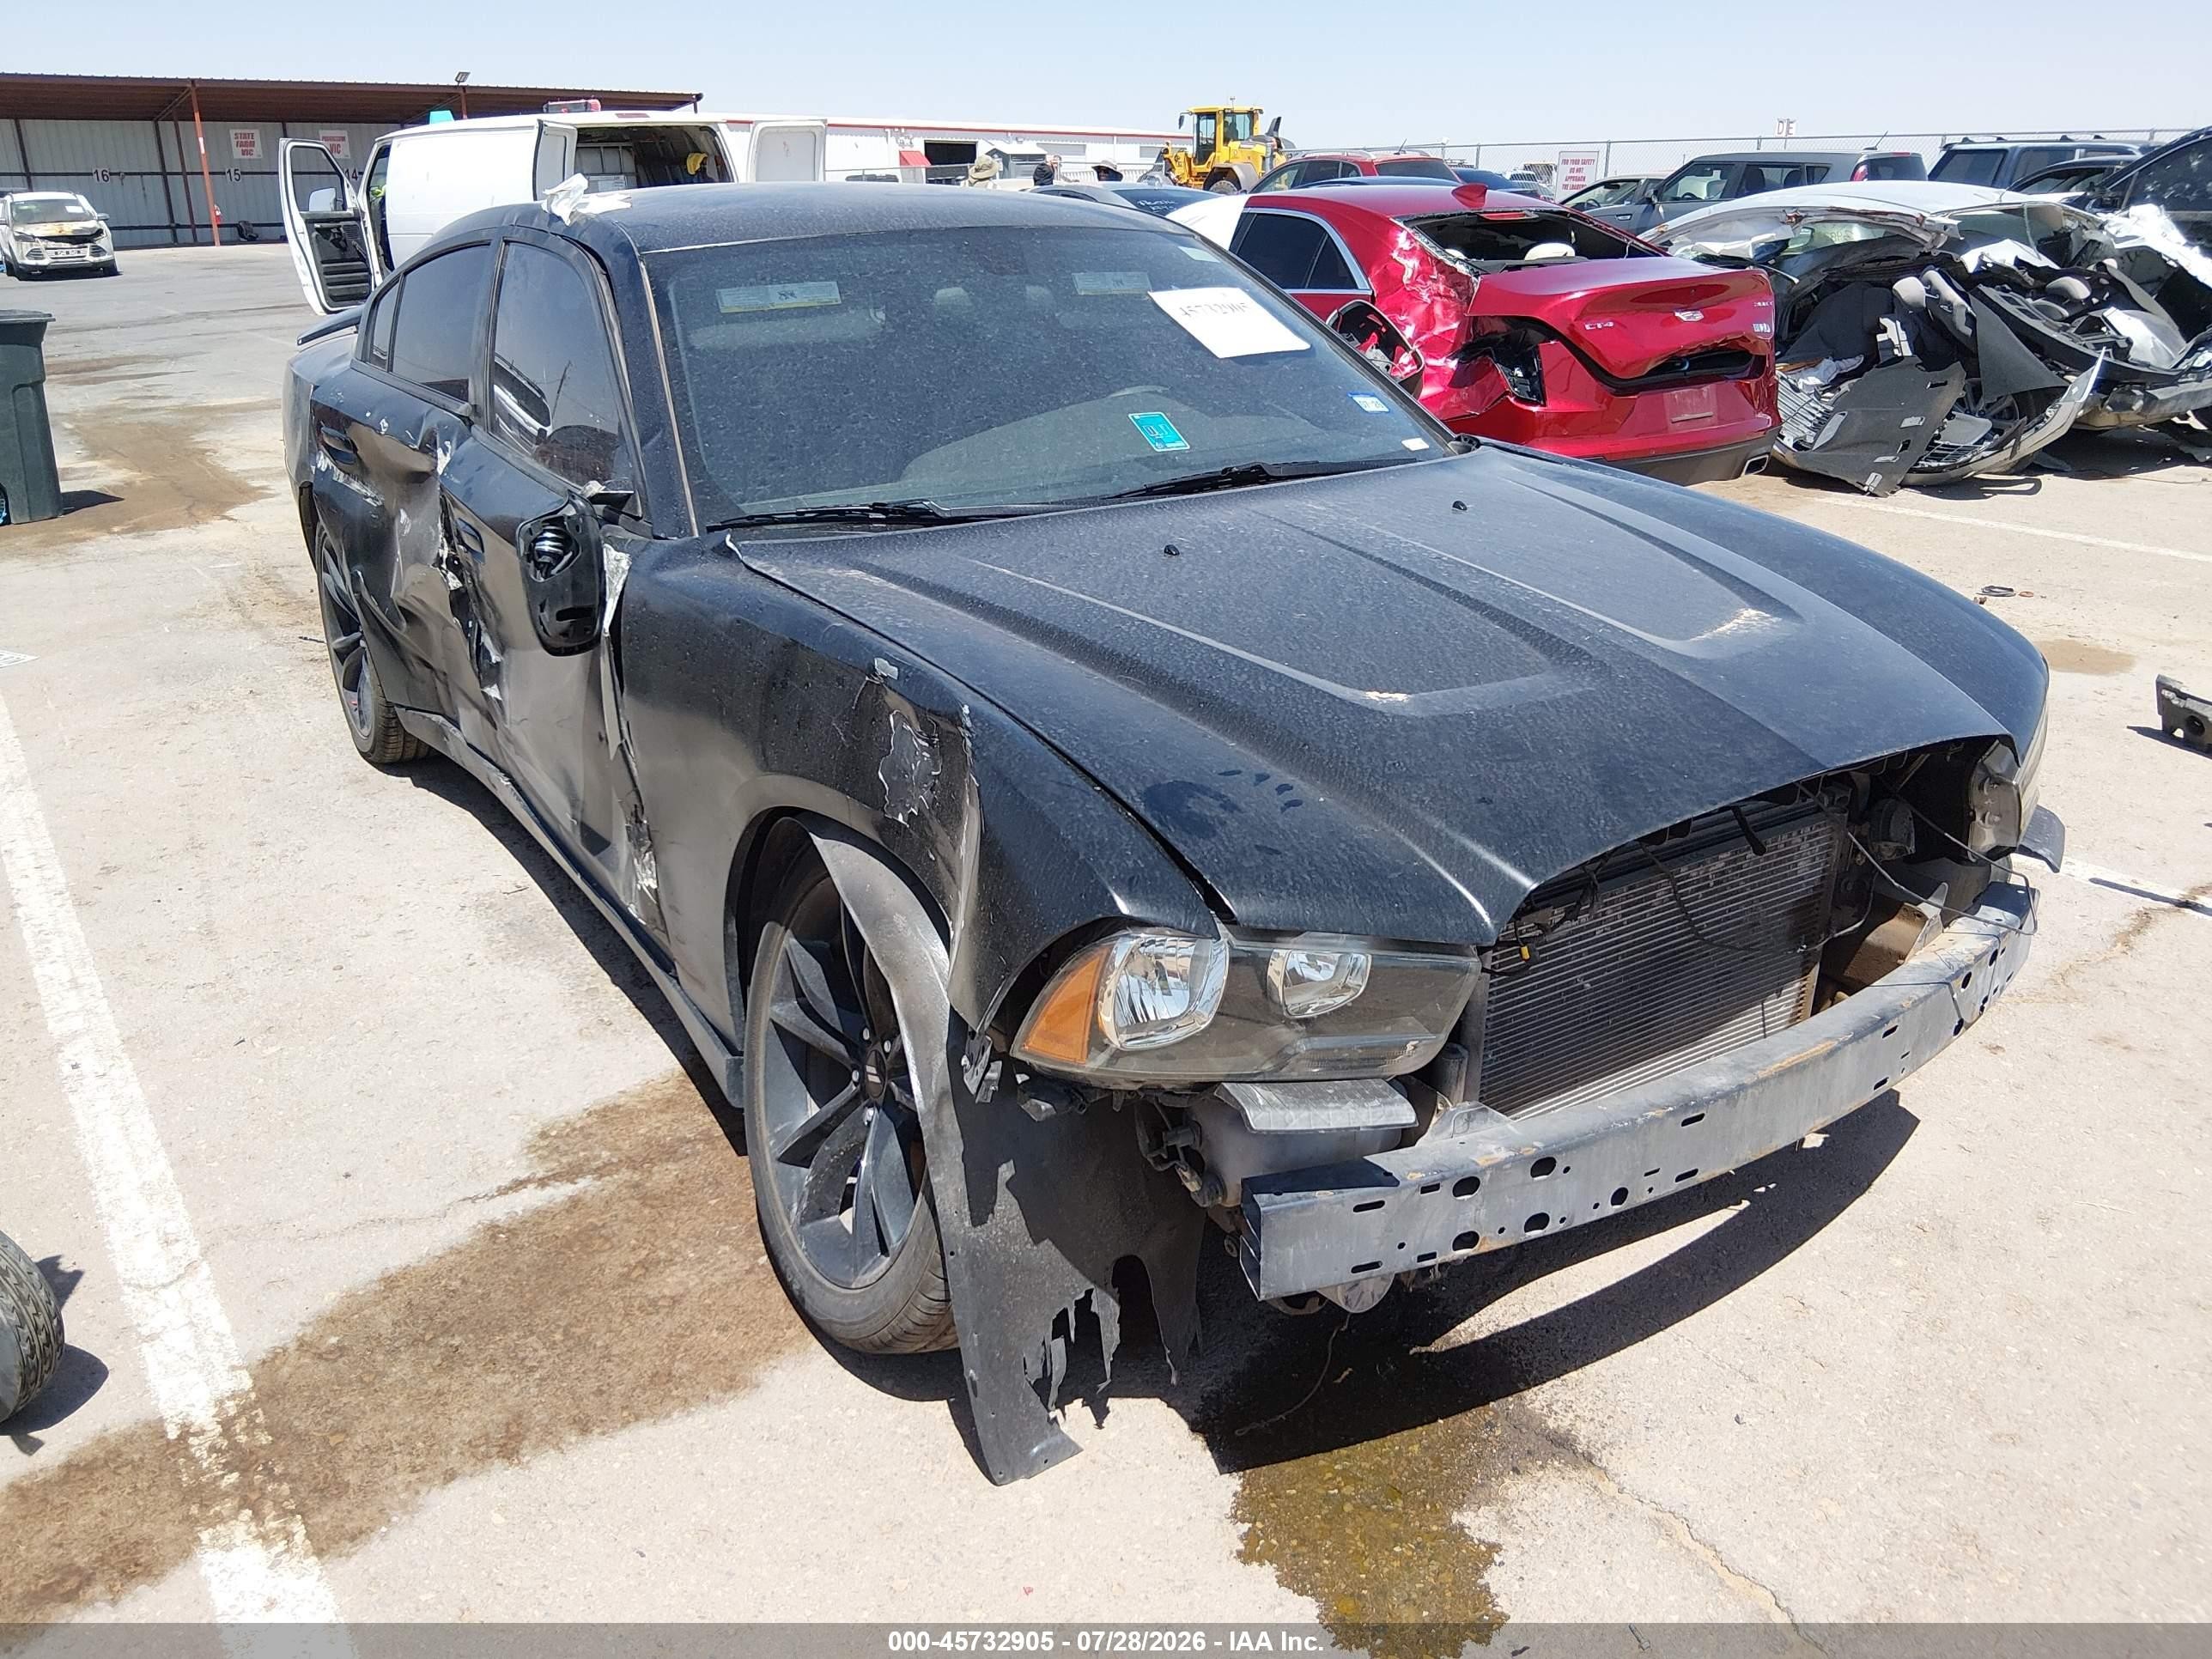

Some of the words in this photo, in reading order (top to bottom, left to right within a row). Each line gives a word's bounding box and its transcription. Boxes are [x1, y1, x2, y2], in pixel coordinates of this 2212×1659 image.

[329, 143, 342, 154] VIC
[94, 169, 109, 182] 16
[227, 168, 240, 182] 15
[344, 168, 358, 180] 14
